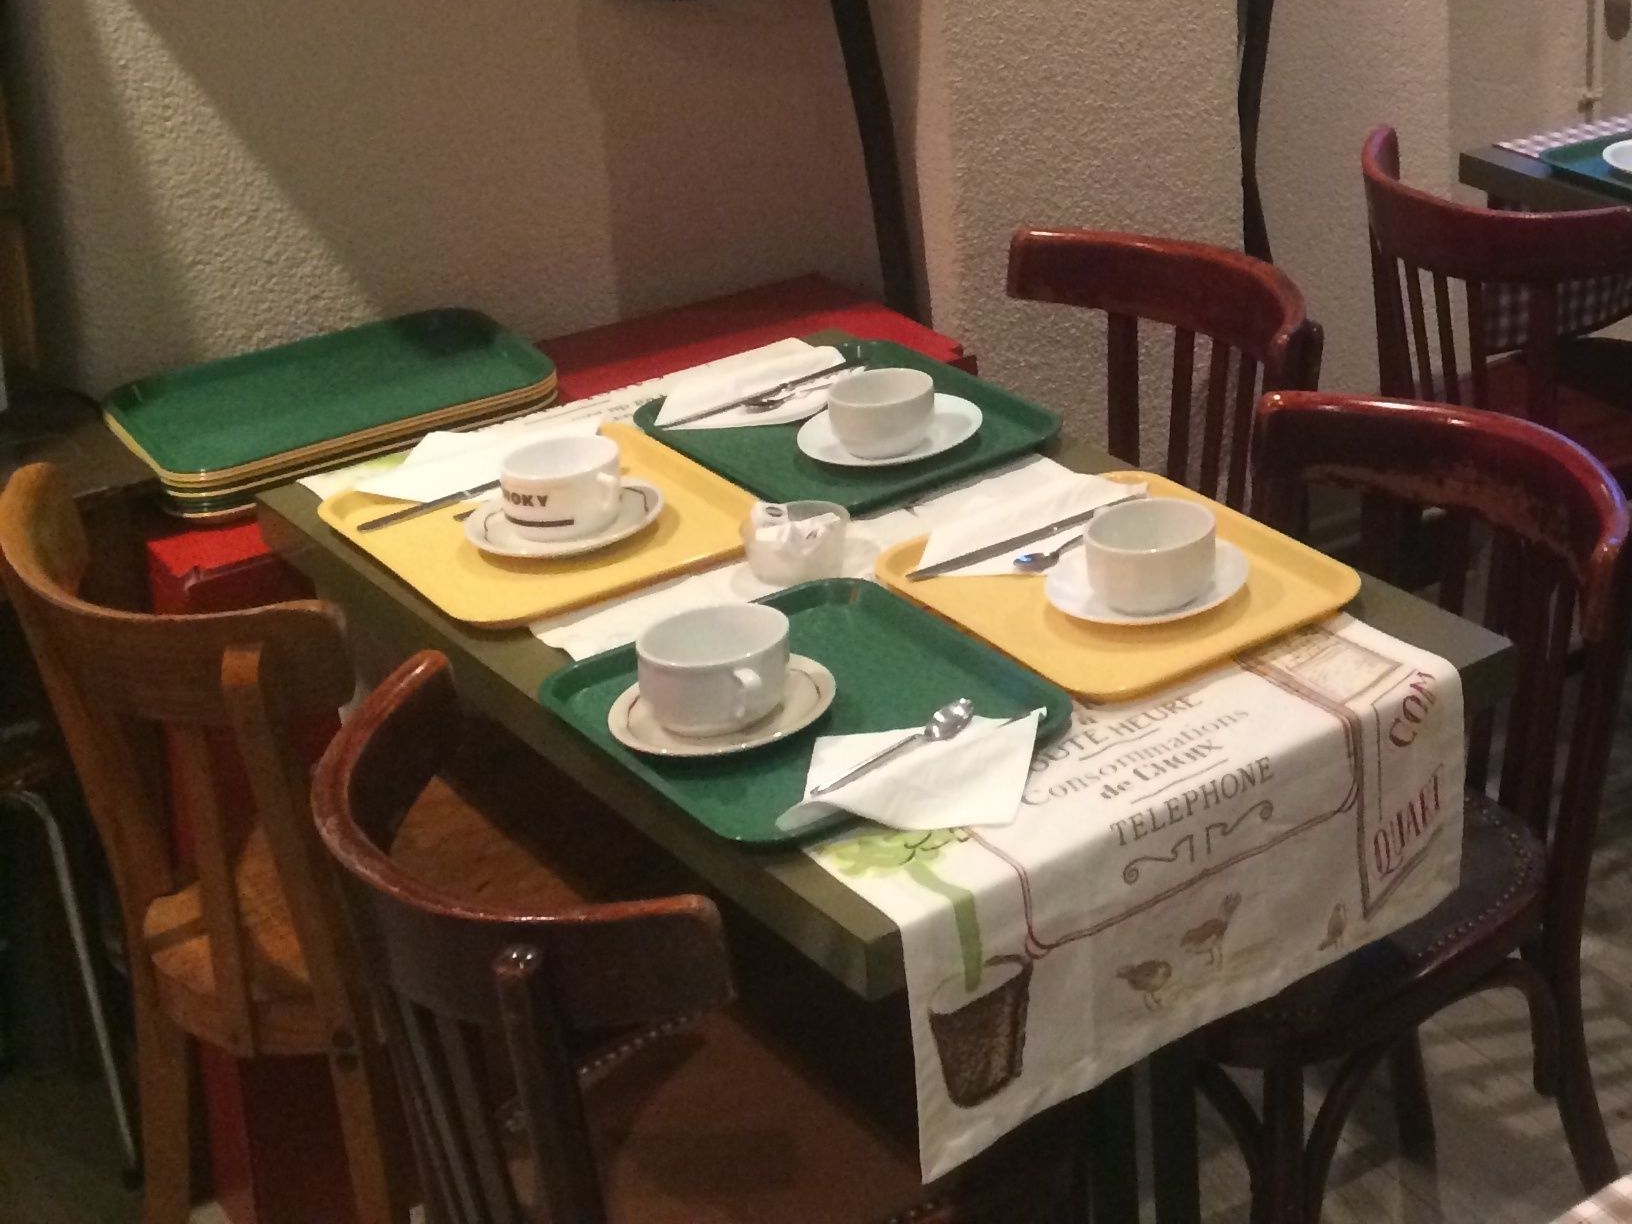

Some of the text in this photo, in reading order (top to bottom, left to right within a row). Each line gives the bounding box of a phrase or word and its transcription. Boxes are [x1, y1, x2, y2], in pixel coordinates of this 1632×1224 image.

[1029, 695, 1203, 772] OUTE HEURE
[1110, 756, 1276, 847] TELEPHONE
